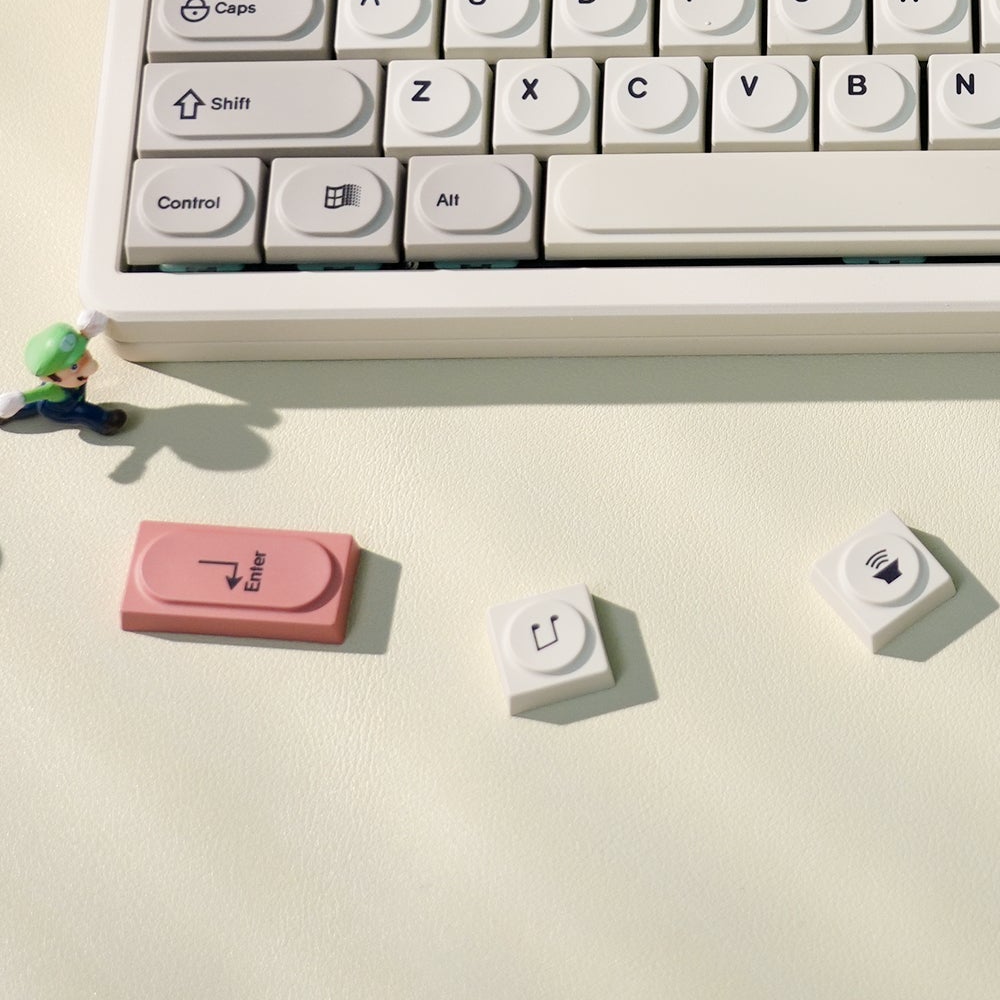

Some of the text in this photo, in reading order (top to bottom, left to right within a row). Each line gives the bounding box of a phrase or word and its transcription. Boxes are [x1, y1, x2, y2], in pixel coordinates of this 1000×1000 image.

[215, 2, 256, 16] Caps
[412, 81, 431, 101] Z
[522, 79, 538, 100] X
[628, 77, 647, 98] C
[741, 76, 758, 96] V
[848, 75, 867, 95] B
[956, 73, 974, 94] N
[211, 97, 250, 110] Shift
[158, 196, 220, 209] Control
[437, 194, 459, 206] Alt
[244, 551, 266, 592] Enter
